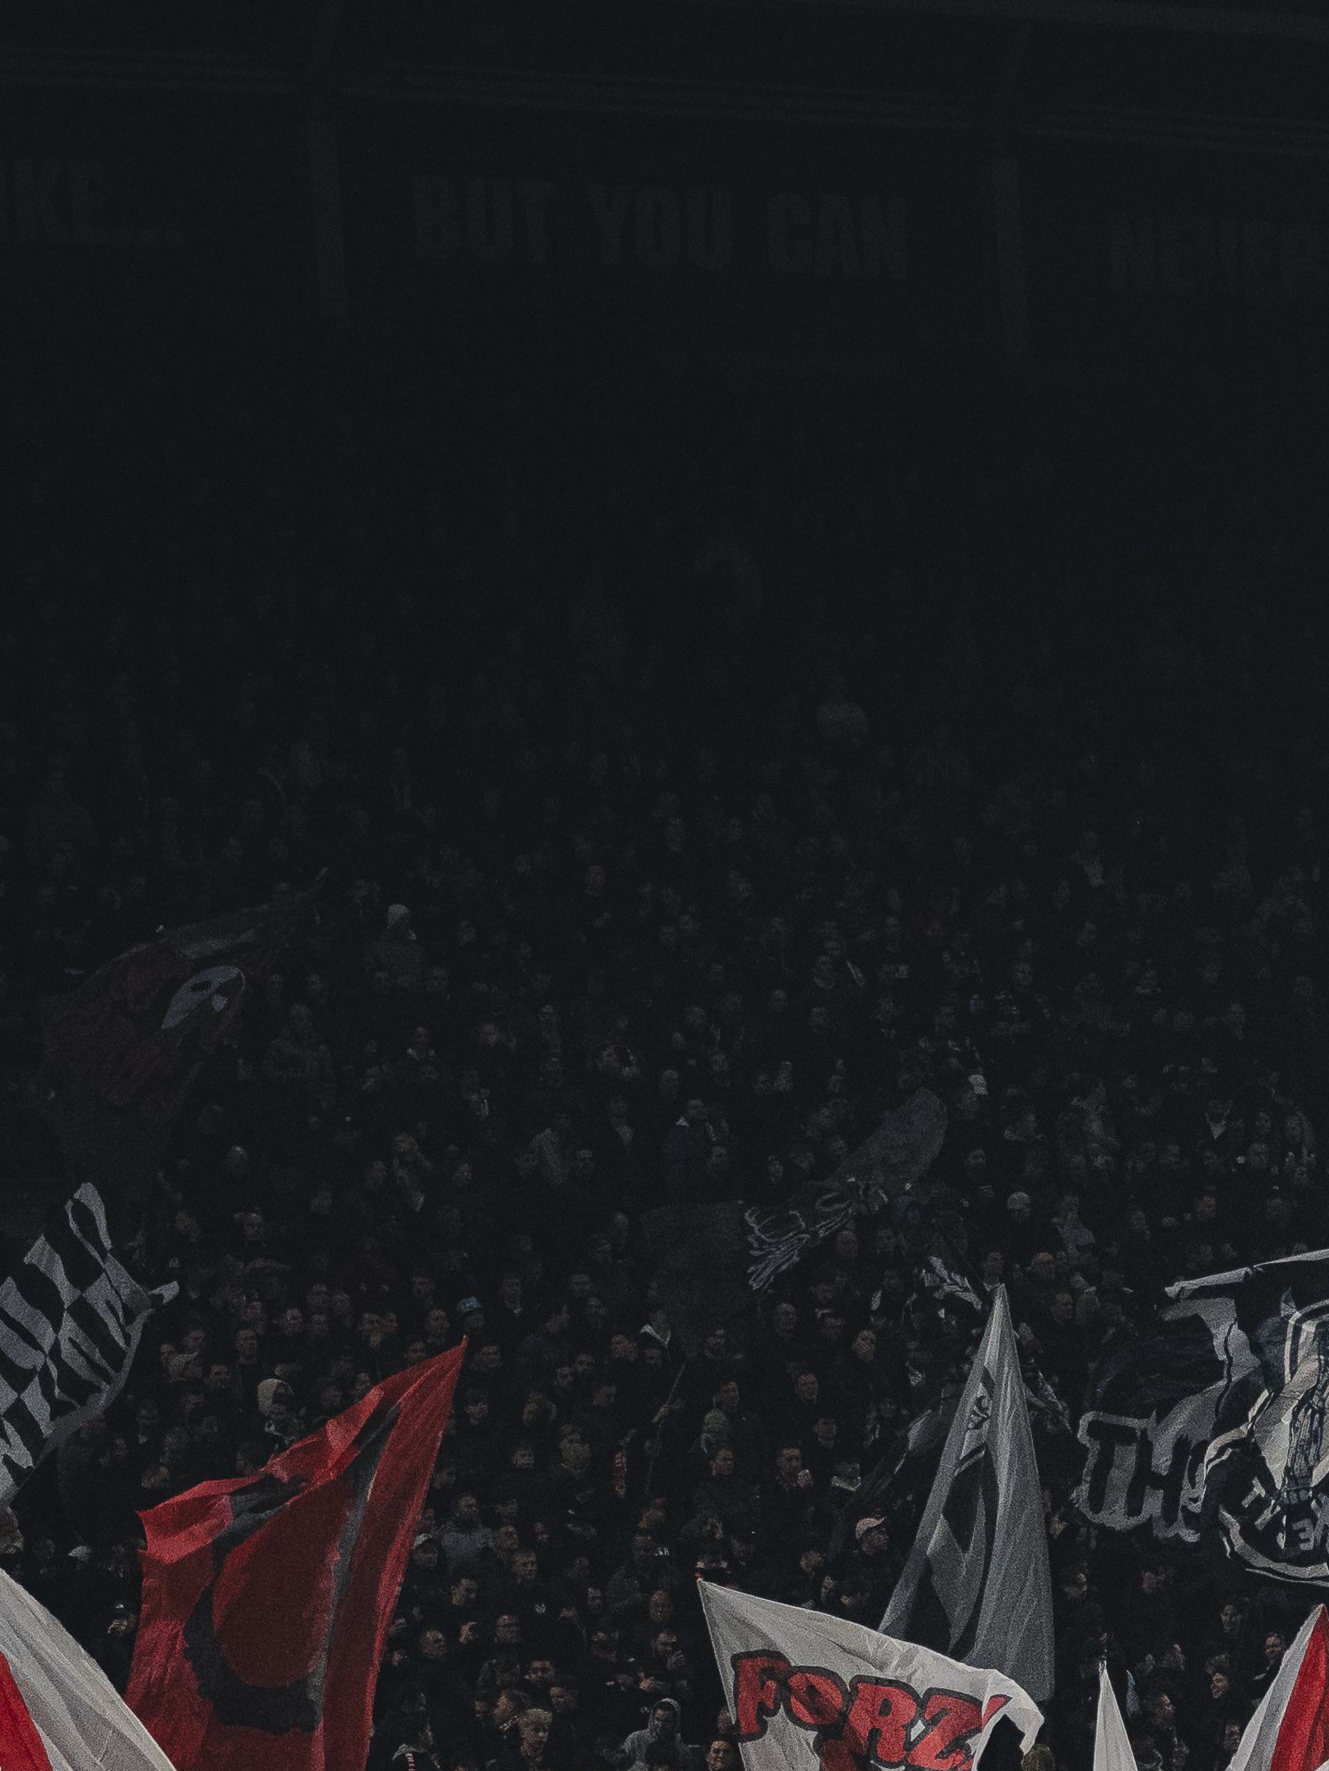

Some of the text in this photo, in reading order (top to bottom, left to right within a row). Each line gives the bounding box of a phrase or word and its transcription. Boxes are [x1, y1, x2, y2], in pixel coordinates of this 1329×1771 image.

[411, 173, 909, 278] BUT YOU CAN
